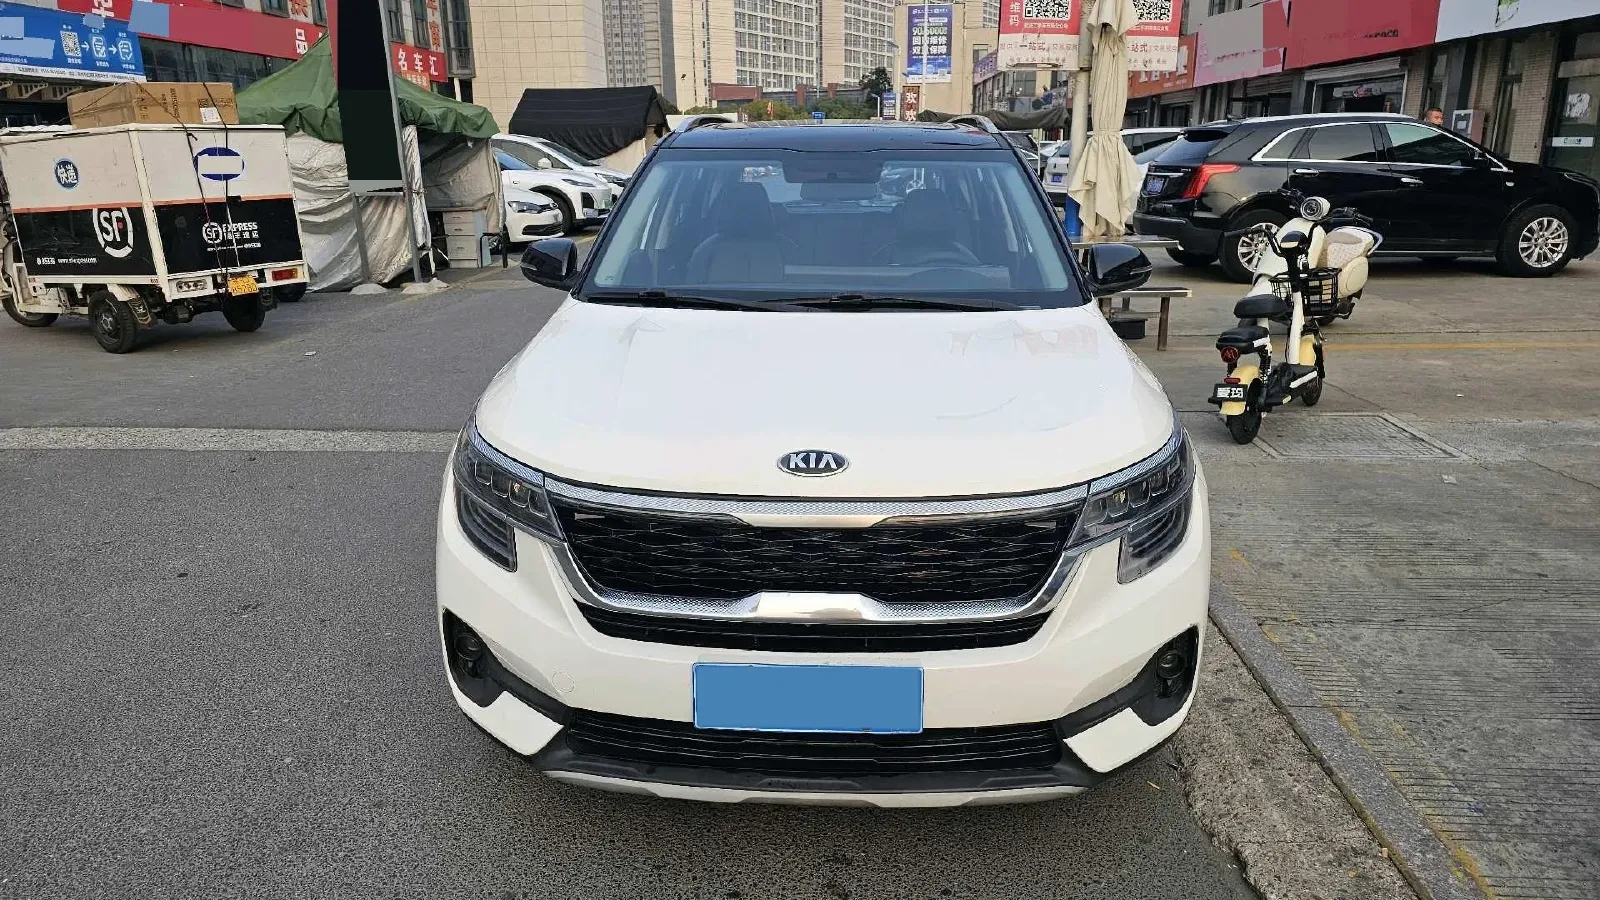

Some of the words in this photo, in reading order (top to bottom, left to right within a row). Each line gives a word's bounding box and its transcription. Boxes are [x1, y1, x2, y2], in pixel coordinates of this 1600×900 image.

[398, 48, 438, 76] 名车汇
[100, 210, 124, 242] SF
[222, 222, 259, 232] EXPRESS
[789, 453, 838, 469] KIA
